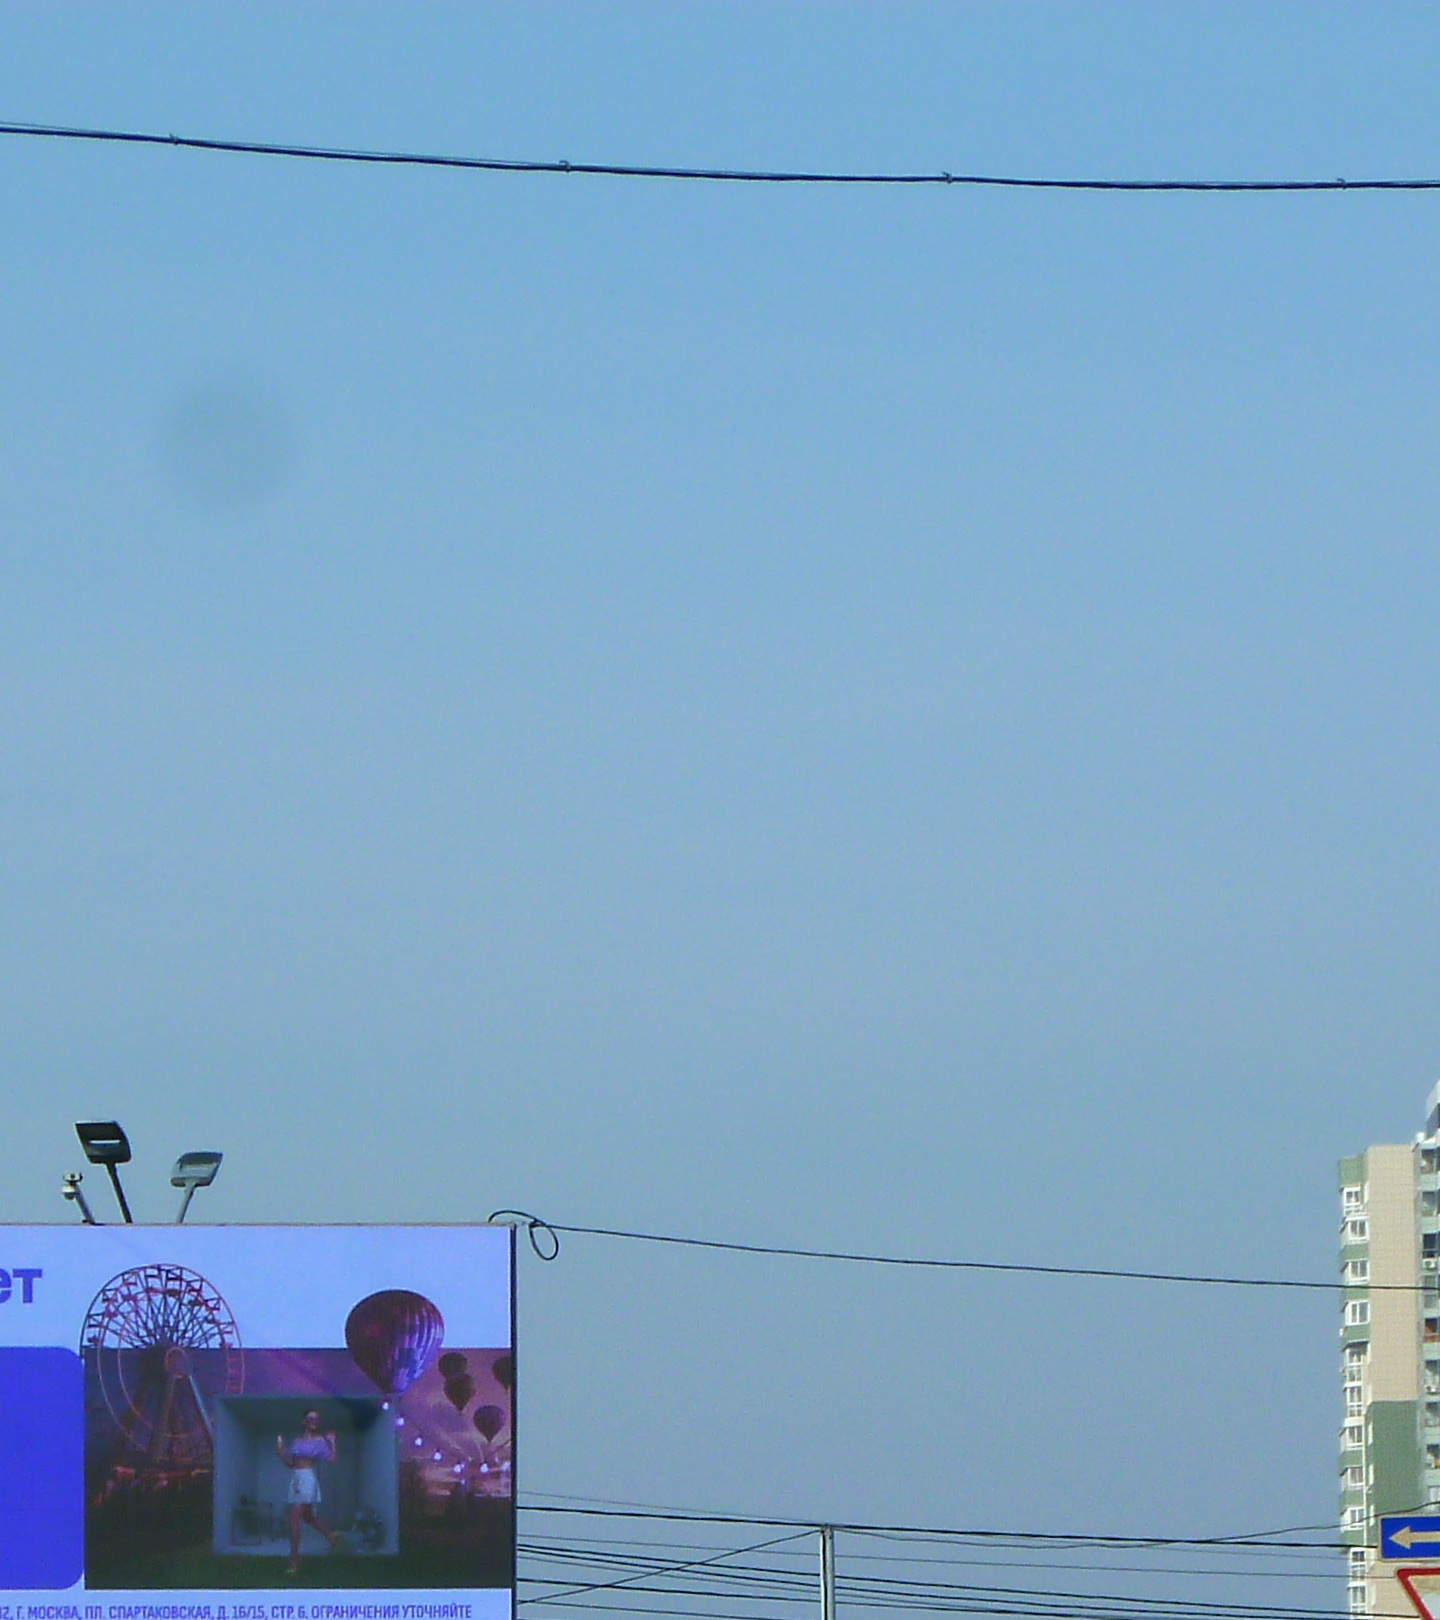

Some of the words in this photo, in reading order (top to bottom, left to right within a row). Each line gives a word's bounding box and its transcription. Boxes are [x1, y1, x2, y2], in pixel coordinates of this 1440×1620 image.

[28, 1605, 83, 1620] МОСКВА,
[109, 1605, 215, 1620] СПАРТАКОВСКАЯ,
[217, 1605, 230, 1620] Д.
[232, 1605, 268, 1620] 16/15,
[311, 1604, 400, 1620] ОГРАНИЧЕНИЯ
[402, 1602, 472, 1620] УТОЧНЯЙТЕ
